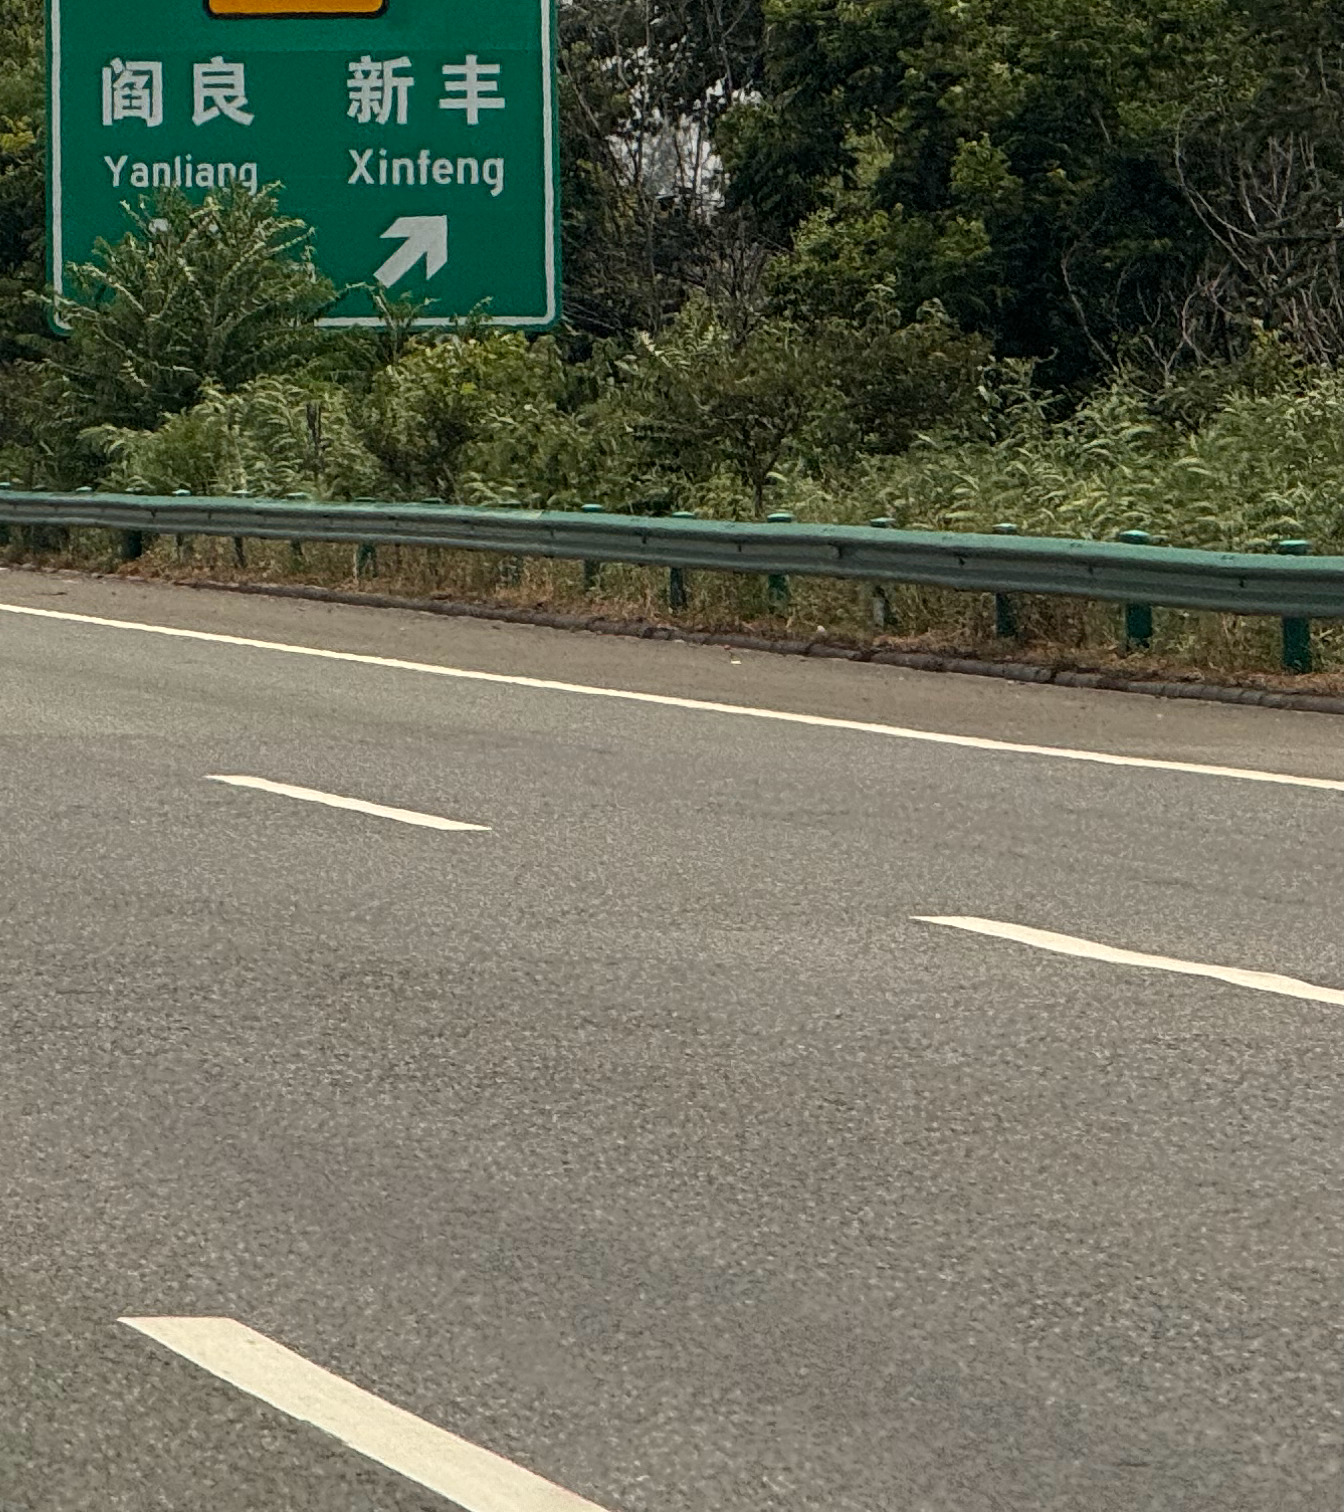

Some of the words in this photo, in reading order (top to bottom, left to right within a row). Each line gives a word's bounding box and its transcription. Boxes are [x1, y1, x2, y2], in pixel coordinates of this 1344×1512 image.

[101, 55, 255, 127] 阎良
[346, 54, 506, 126] 新丰
[103, 153, 258, 196] Yanliang
[348, 148, 505, 197] Xinfeng
